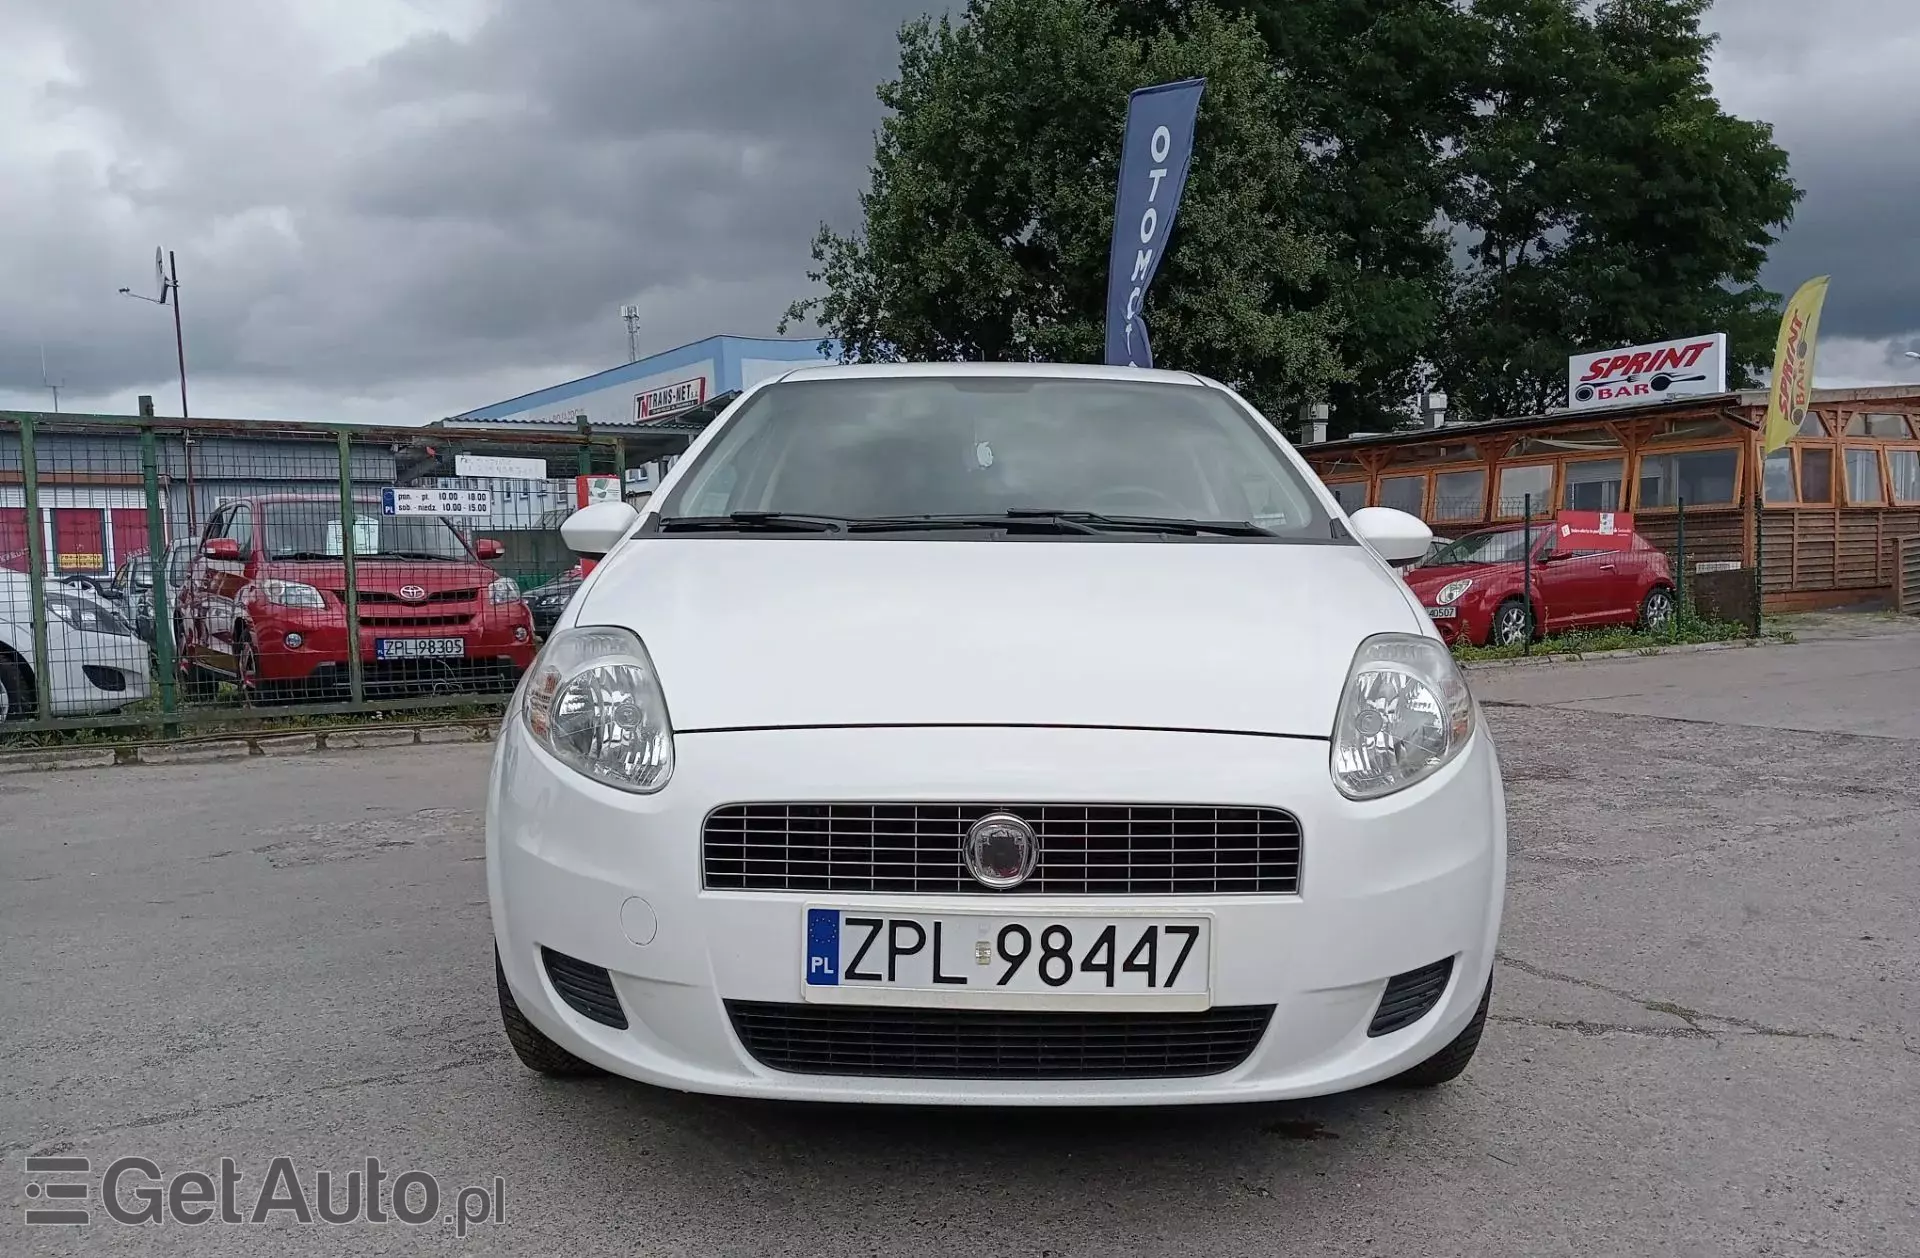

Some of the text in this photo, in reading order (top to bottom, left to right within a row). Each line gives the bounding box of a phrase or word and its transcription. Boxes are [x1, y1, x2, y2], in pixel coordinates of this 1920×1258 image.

[1580, 341, 1714, 382] SPRINT
[1779, 308, 1803, 421] SPRINT
[1598, 383, 1649, 400] BAR
[1796, 359, 1805, 405] BAR
[648, 384, 691, 409] TRANS-NET
[438, 492, 458, 501] 10.00
[385, 506, 394, 514] PL
[442, 502, 461, 511] 10.00
[468, 503, 487, 512] 15.00
[385, 639, 462, 655] ZPL 98305
[844, 917, 1200, 988] ZPL 98447
[811, 956, 834, 975] PL
